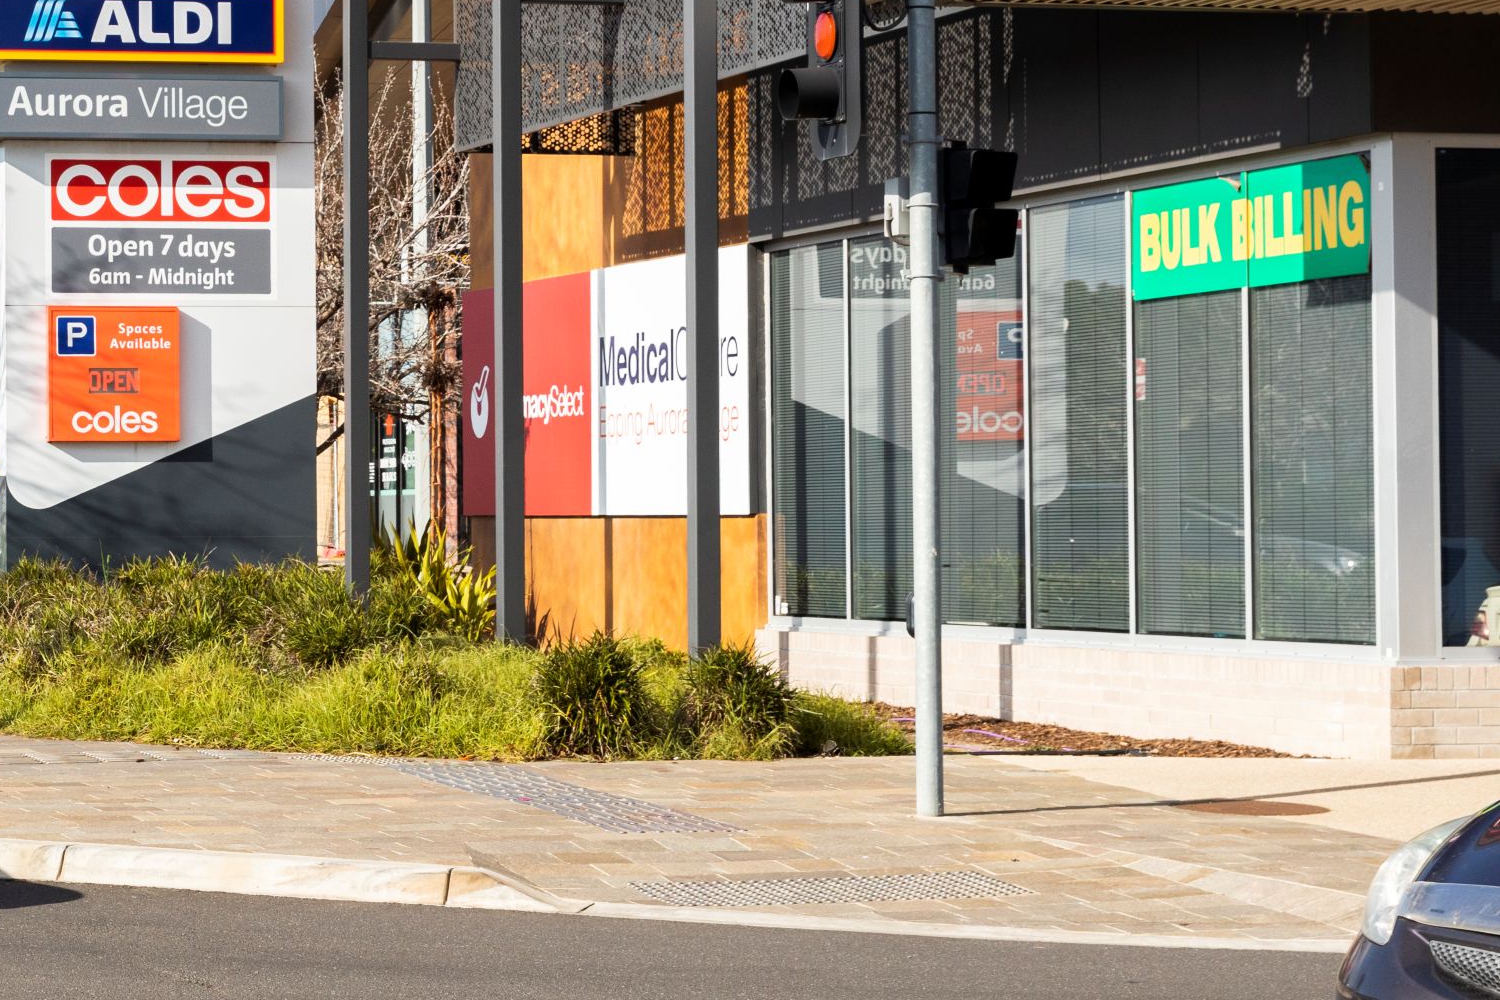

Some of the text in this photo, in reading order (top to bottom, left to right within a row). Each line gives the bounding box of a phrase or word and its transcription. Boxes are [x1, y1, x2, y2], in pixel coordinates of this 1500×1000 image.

[91, 0, 232, 45] ALDI
[7, 85, 248, 127] Aurora Village
[55, 160, 266, 218] coles
[1139, 180, 1364, 273] BULK BILLING
[88, 234, 235, 263] Open 7 days
[89, 268, 130, 285] 6am
[148, 267, 234, 289] Midnight
[67, 322, 87, 347] P
[109, 337, 171, 350] Available
[118, 322, 163, 336] Spaces
[599, 326, 739, 388] MedicalCre
[90, 370, 138, 392] OPEN
[71, 405, 159, 434] coles
